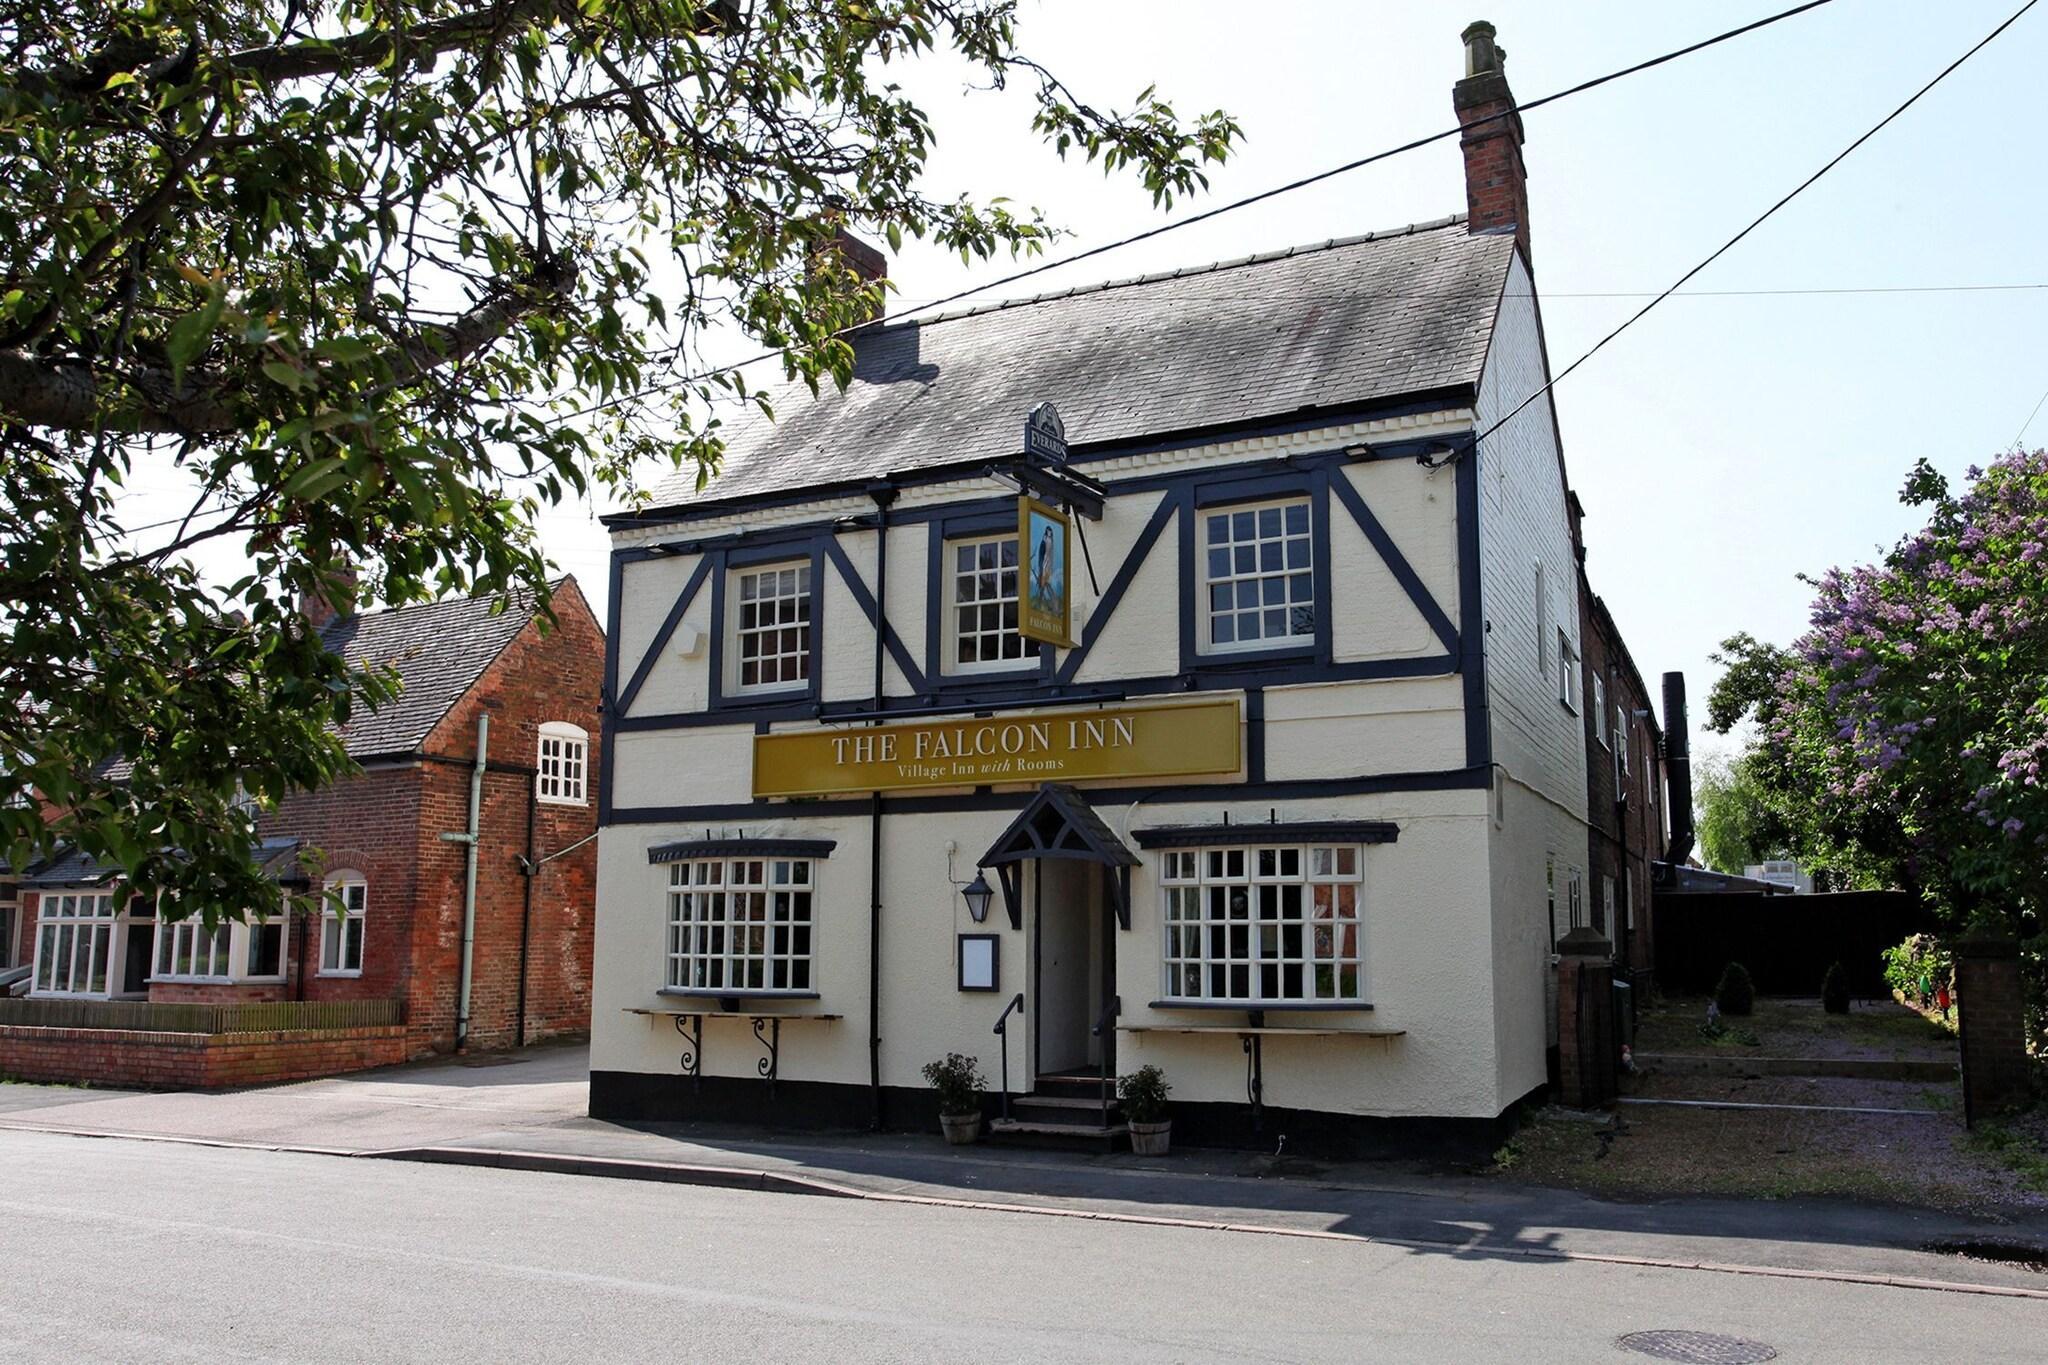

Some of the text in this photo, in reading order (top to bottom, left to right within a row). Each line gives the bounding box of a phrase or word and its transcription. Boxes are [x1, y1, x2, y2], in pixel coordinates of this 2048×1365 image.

[1031, 430, 1067, 460] EVERARDS
[832, 717, 1135, 764] THE FALCON INN
[898, 758, 1064, 780] Village Inn with Rooms
